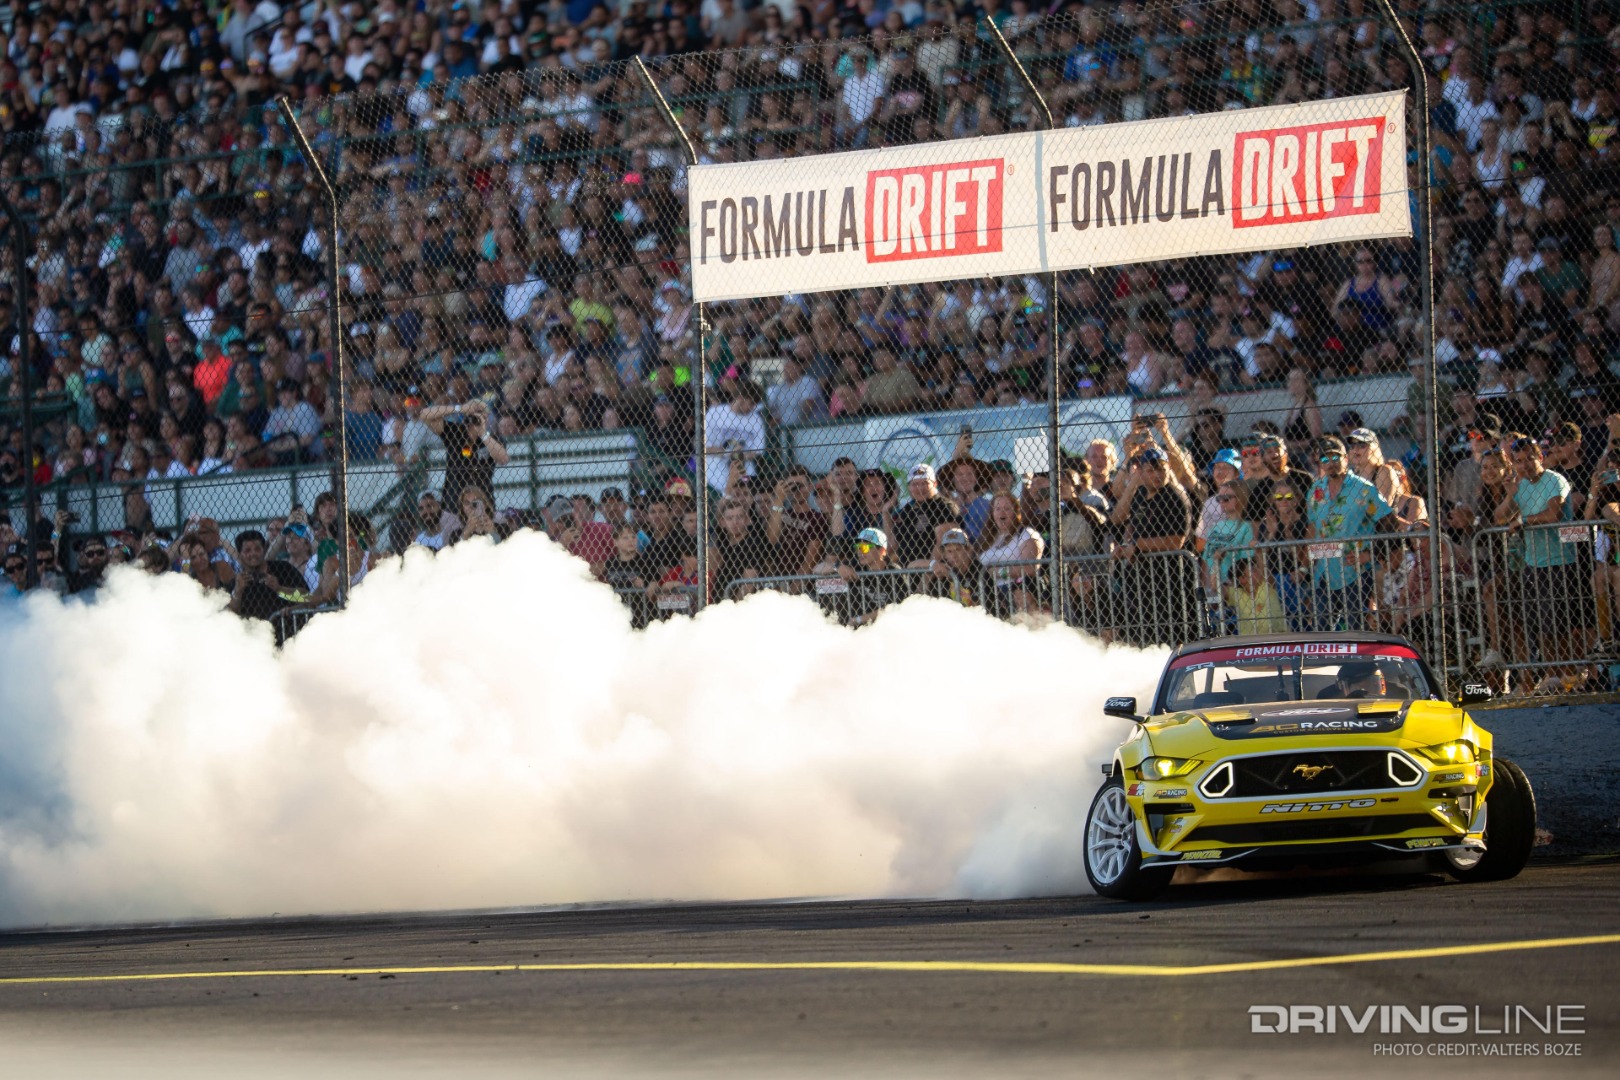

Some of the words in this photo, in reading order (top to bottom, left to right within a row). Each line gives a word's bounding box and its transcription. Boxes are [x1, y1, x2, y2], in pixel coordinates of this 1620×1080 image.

[1050, 149, 1225, 232] FORMULA
[1241, 124, 1378, 221] DRIFT
[700, 187, 860, 264] FORMULA
[873, 165, 997, 256] DRIFT
[1236, 645, 1302, 657] FORMULA
[1306, 644, 1355, 653] DRIFT
[1225, 655, 1319, 665] MUSTANG
[1464, 684, 1492, 696] Ford
[1104, 699, 1134, 707] Ford
[1300, 721, 1378, 729] RACING
[1259, 798, 1378, 814] NITTO
